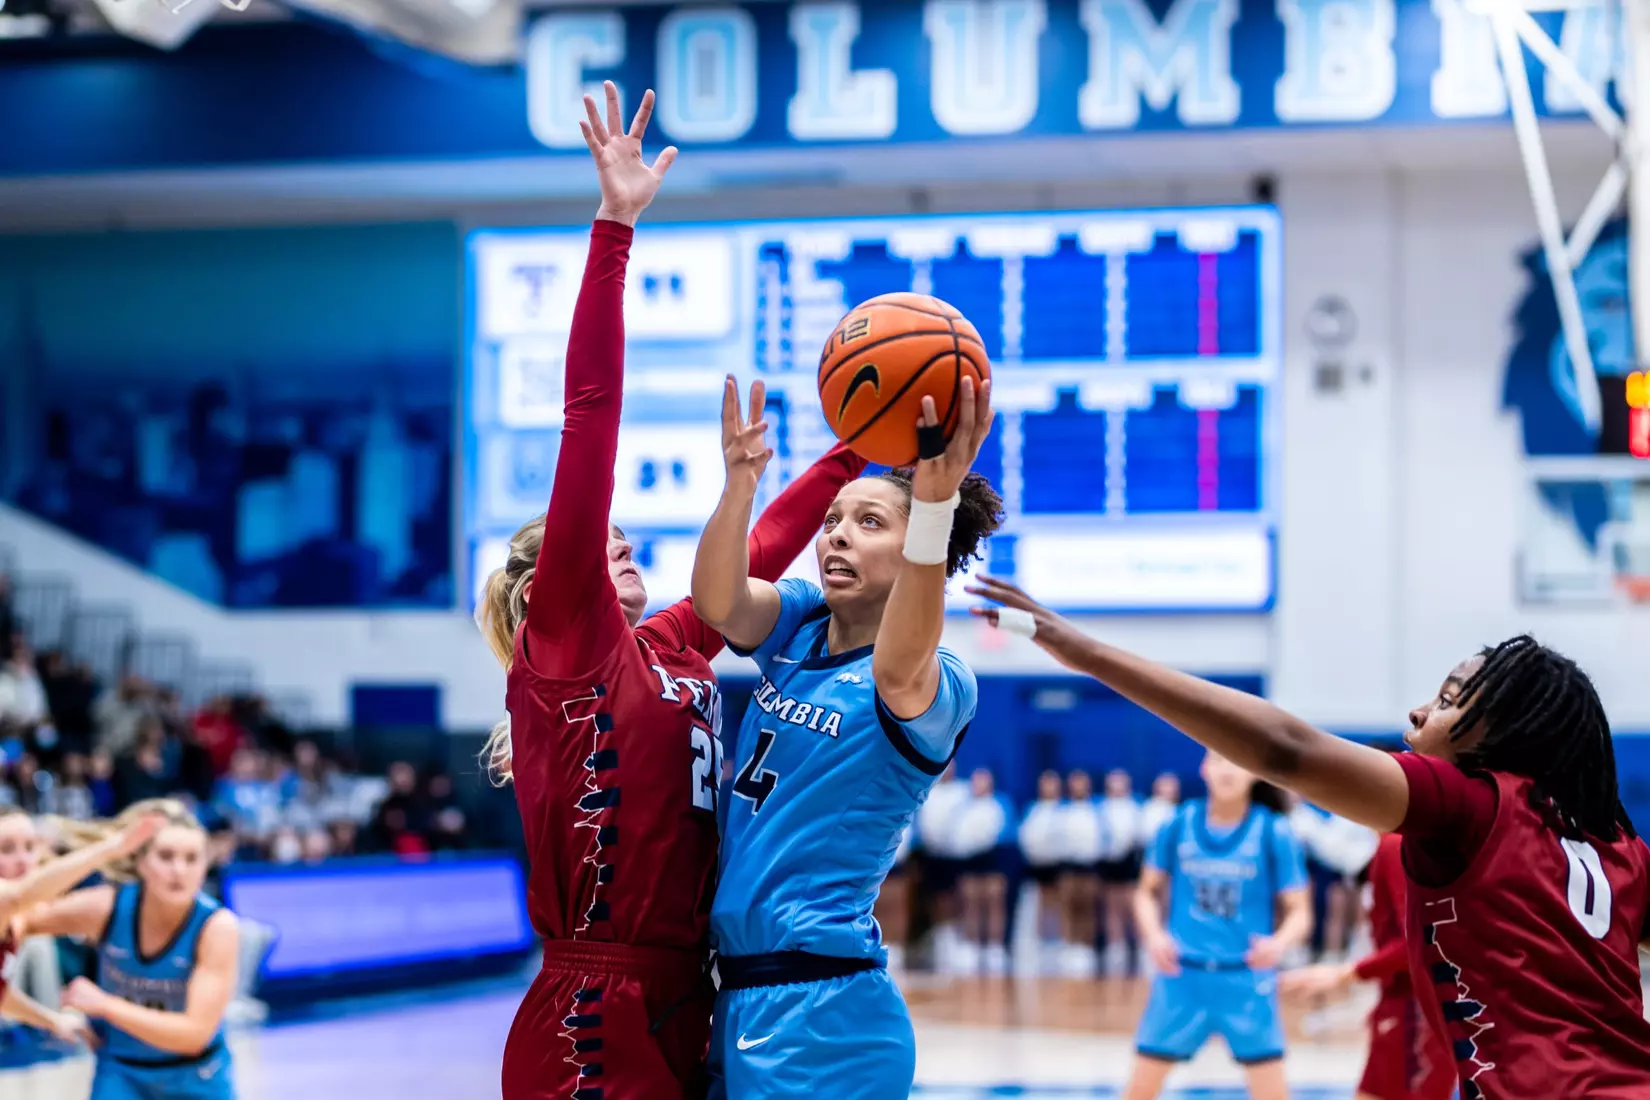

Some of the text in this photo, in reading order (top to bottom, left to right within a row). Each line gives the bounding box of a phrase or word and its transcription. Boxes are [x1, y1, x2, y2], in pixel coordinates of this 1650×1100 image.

[650, 664, 723, 738] PEN
[733, 727, 779, 816] 4
[1560, 836, 1612, 940] 0
